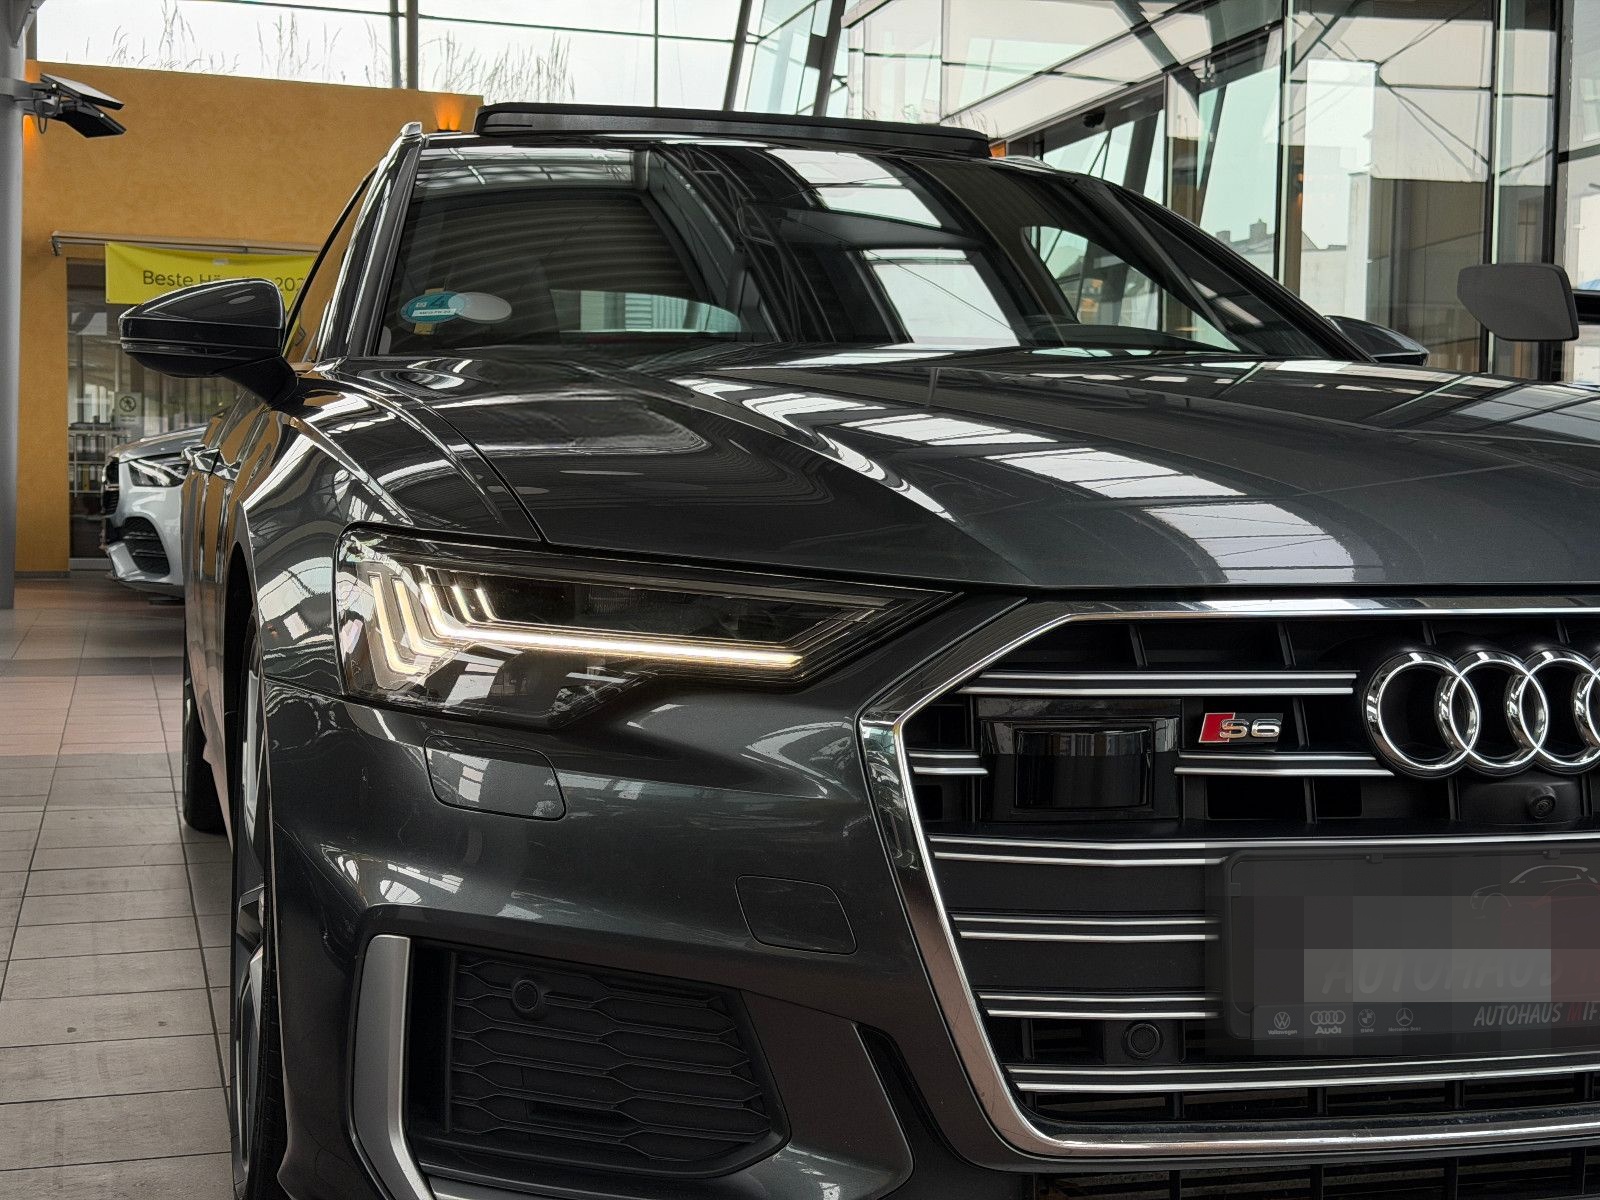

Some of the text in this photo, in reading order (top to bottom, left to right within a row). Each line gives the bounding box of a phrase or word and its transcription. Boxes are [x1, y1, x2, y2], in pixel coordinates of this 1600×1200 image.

[143, 270, 194, 287] Beste
[1219, 718, 1282, 739] S6
[1473, 1000, 1600, 1027] AUTOHAUS MIF
[1314, 1026, 1342, 1035] Audi
